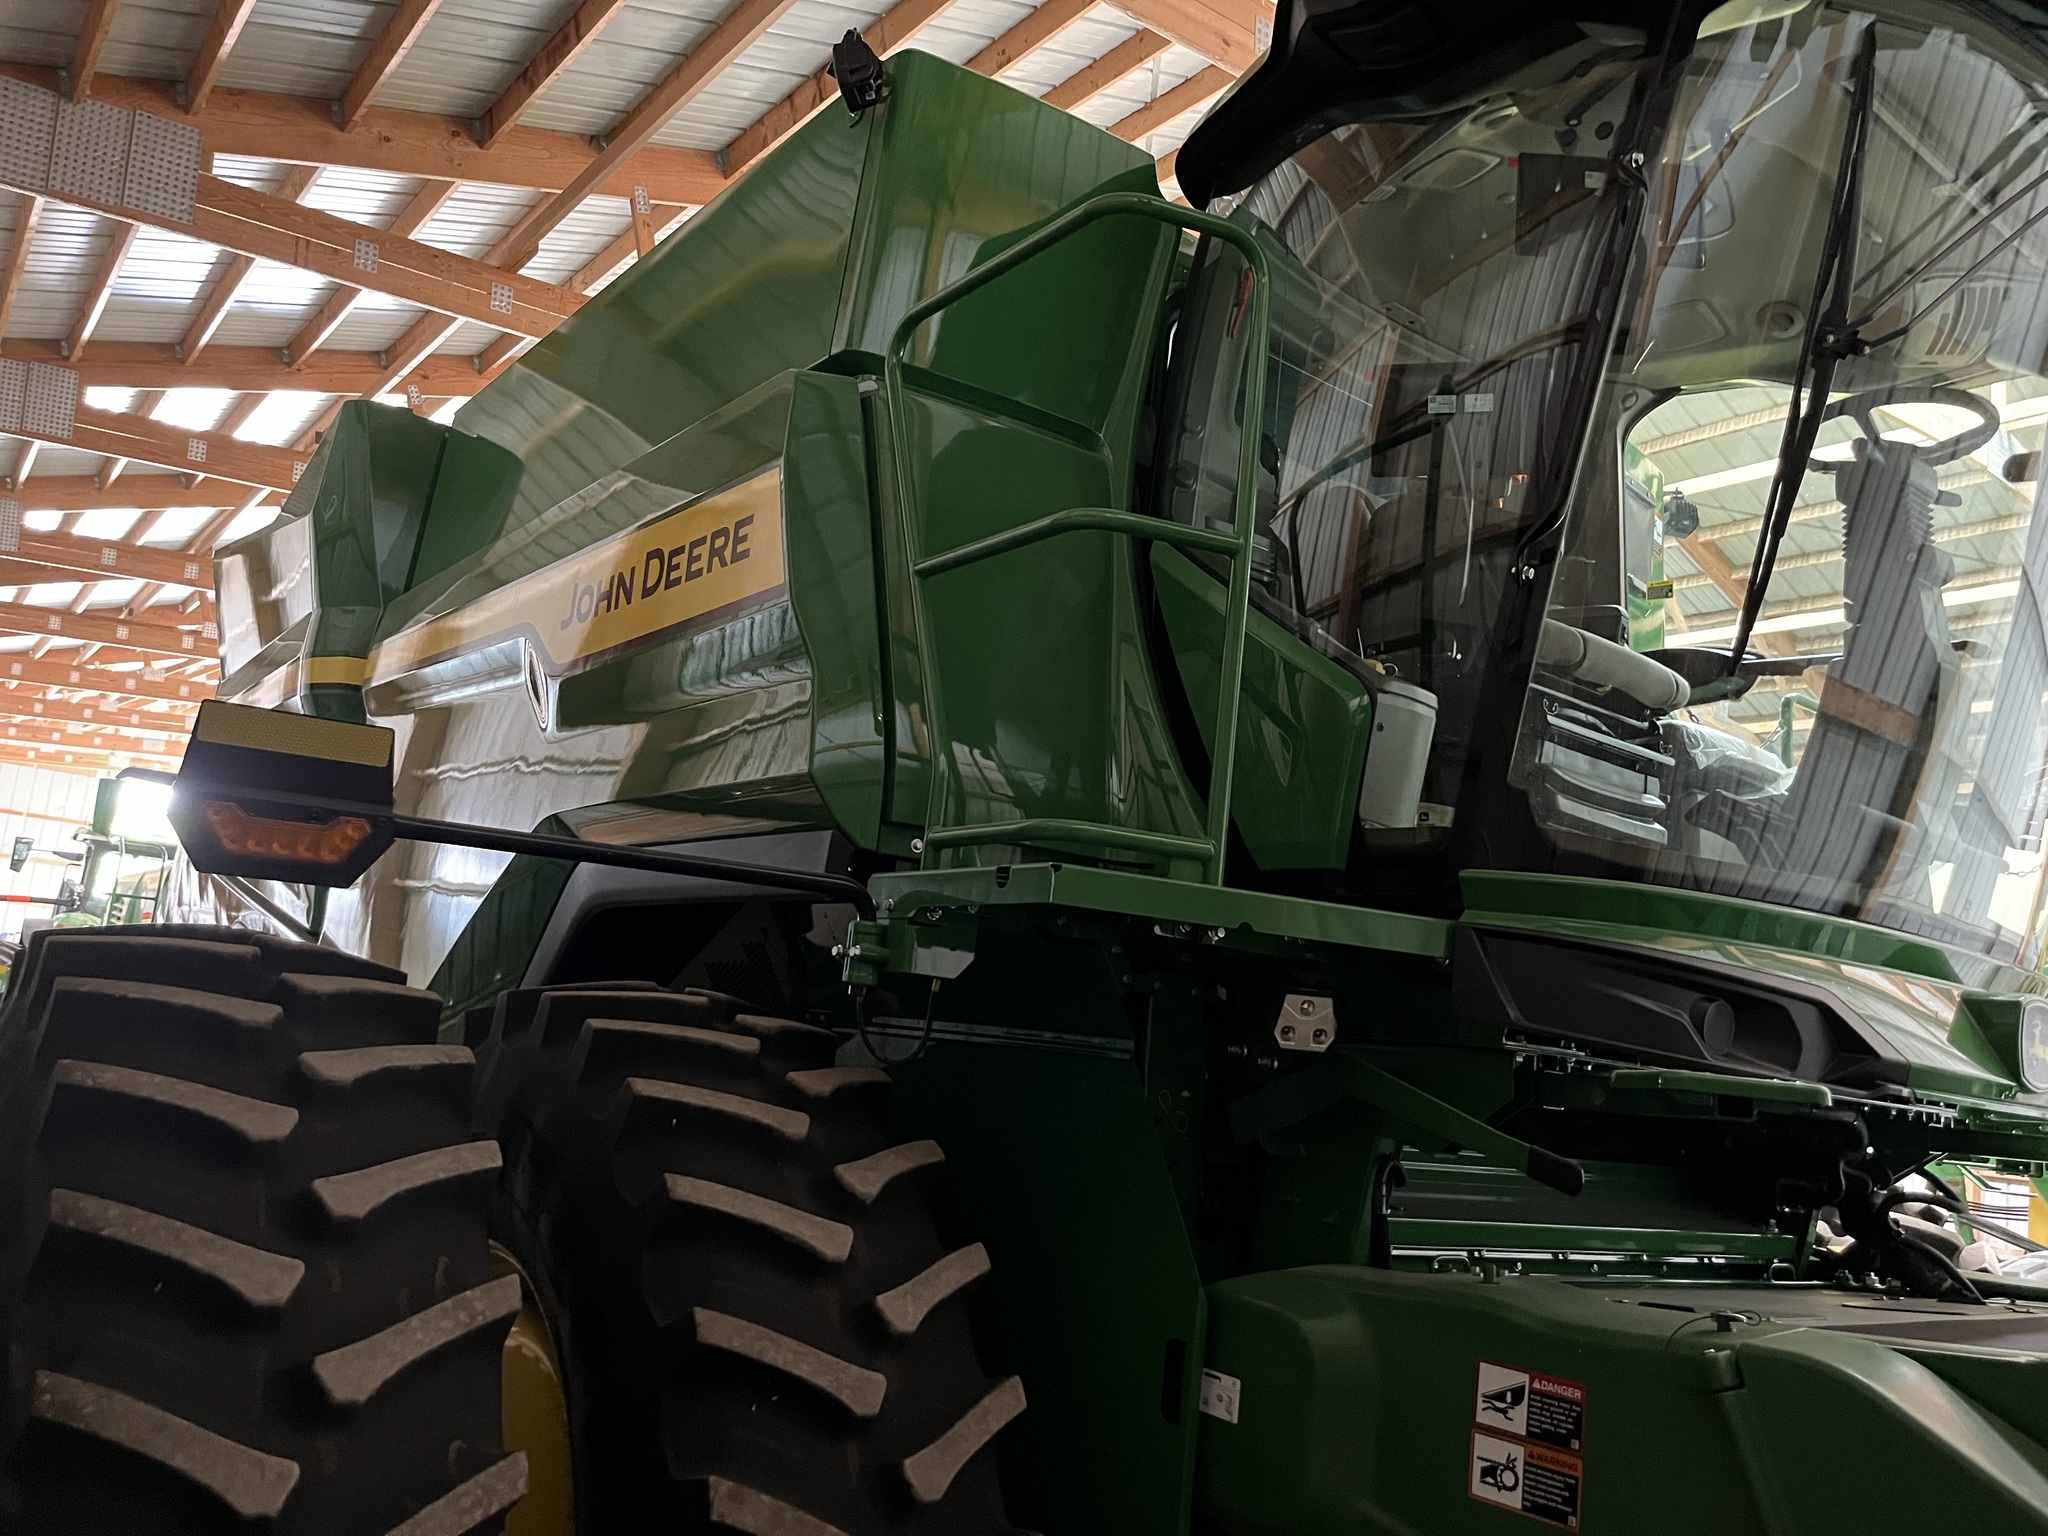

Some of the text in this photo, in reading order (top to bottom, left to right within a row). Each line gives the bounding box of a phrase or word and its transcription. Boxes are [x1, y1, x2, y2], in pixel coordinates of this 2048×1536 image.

[561, 513, 754, 630] JOHN DEERE
[1541, 1380, 1581, 1399] DANGER
[1536, 1453, 1577, 1472] WARNING
